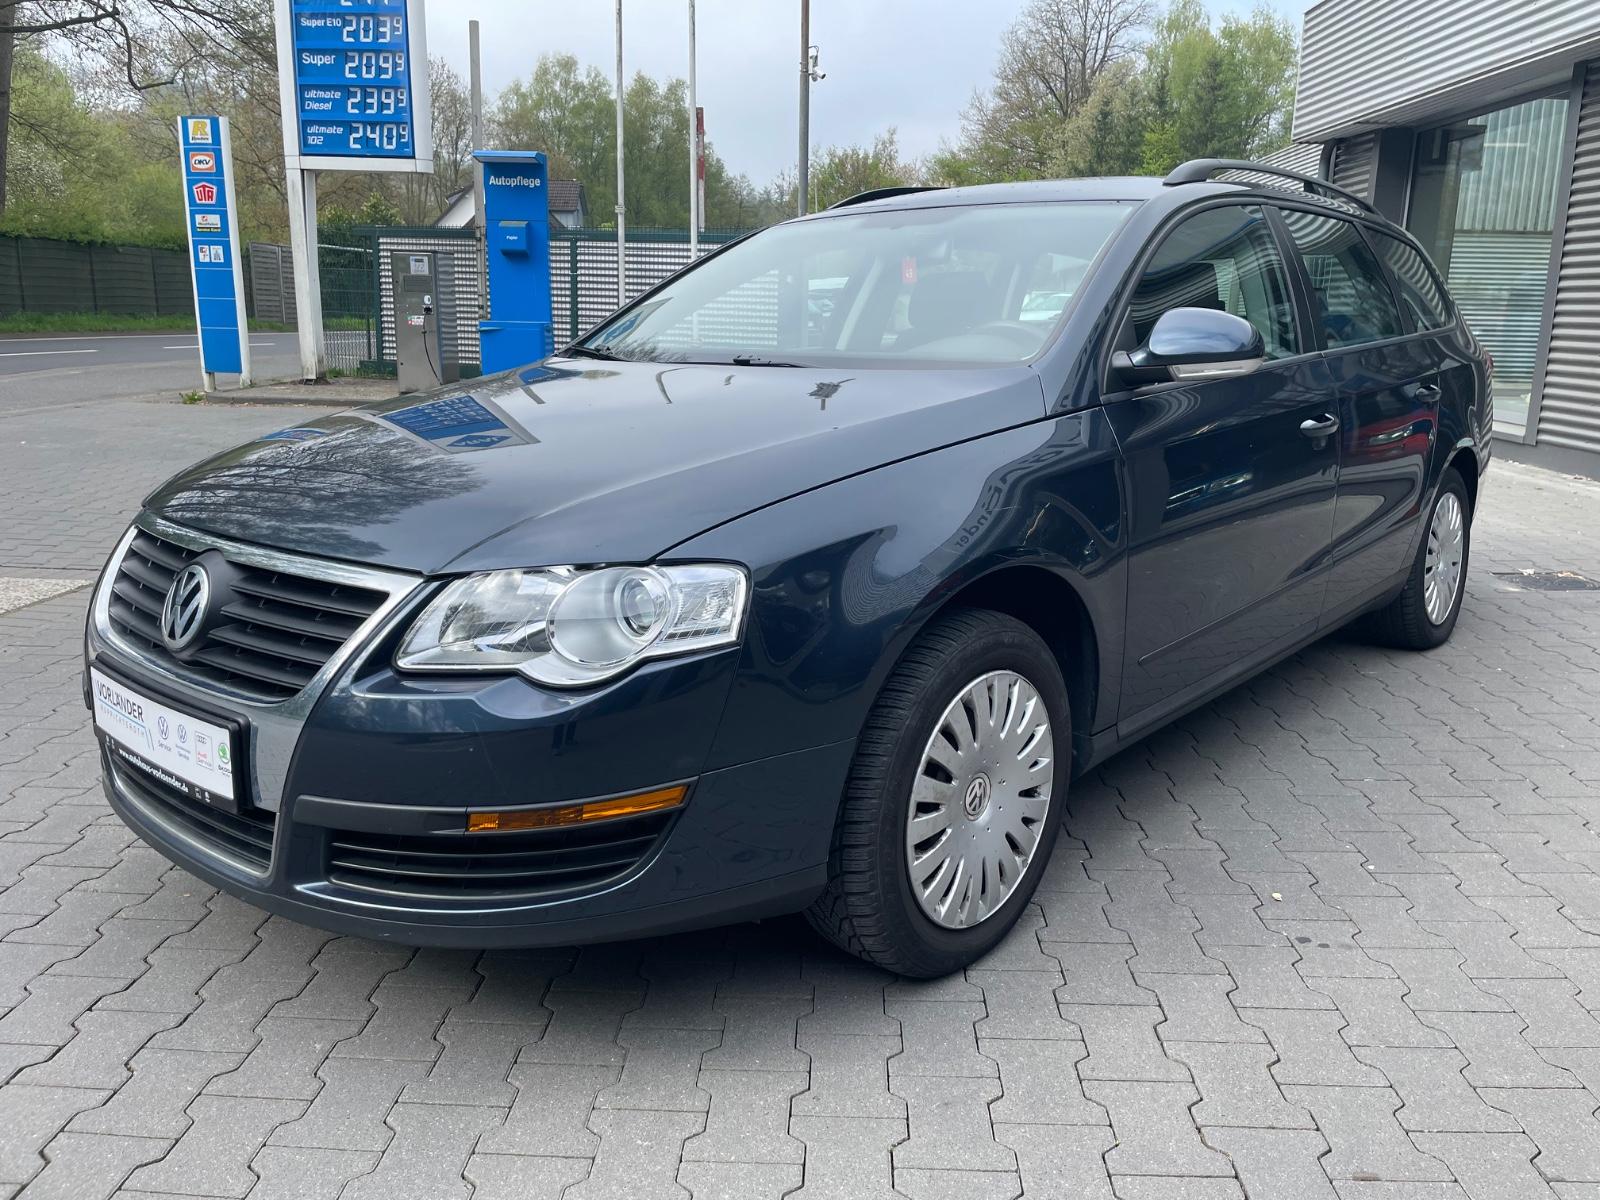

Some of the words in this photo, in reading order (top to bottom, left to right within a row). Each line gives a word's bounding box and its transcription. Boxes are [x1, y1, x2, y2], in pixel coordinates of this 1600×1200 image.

[300, 18, 325, 28] Super
[327, 18, 341, 27] E10
[302, 52, 336, 66] Super
[304, 101, 332, 110] Diesel
[307, 135, 324, 144] 102
[489, 175, 541, 188] Autopflege
[196, 187, 214, 202] UTA
